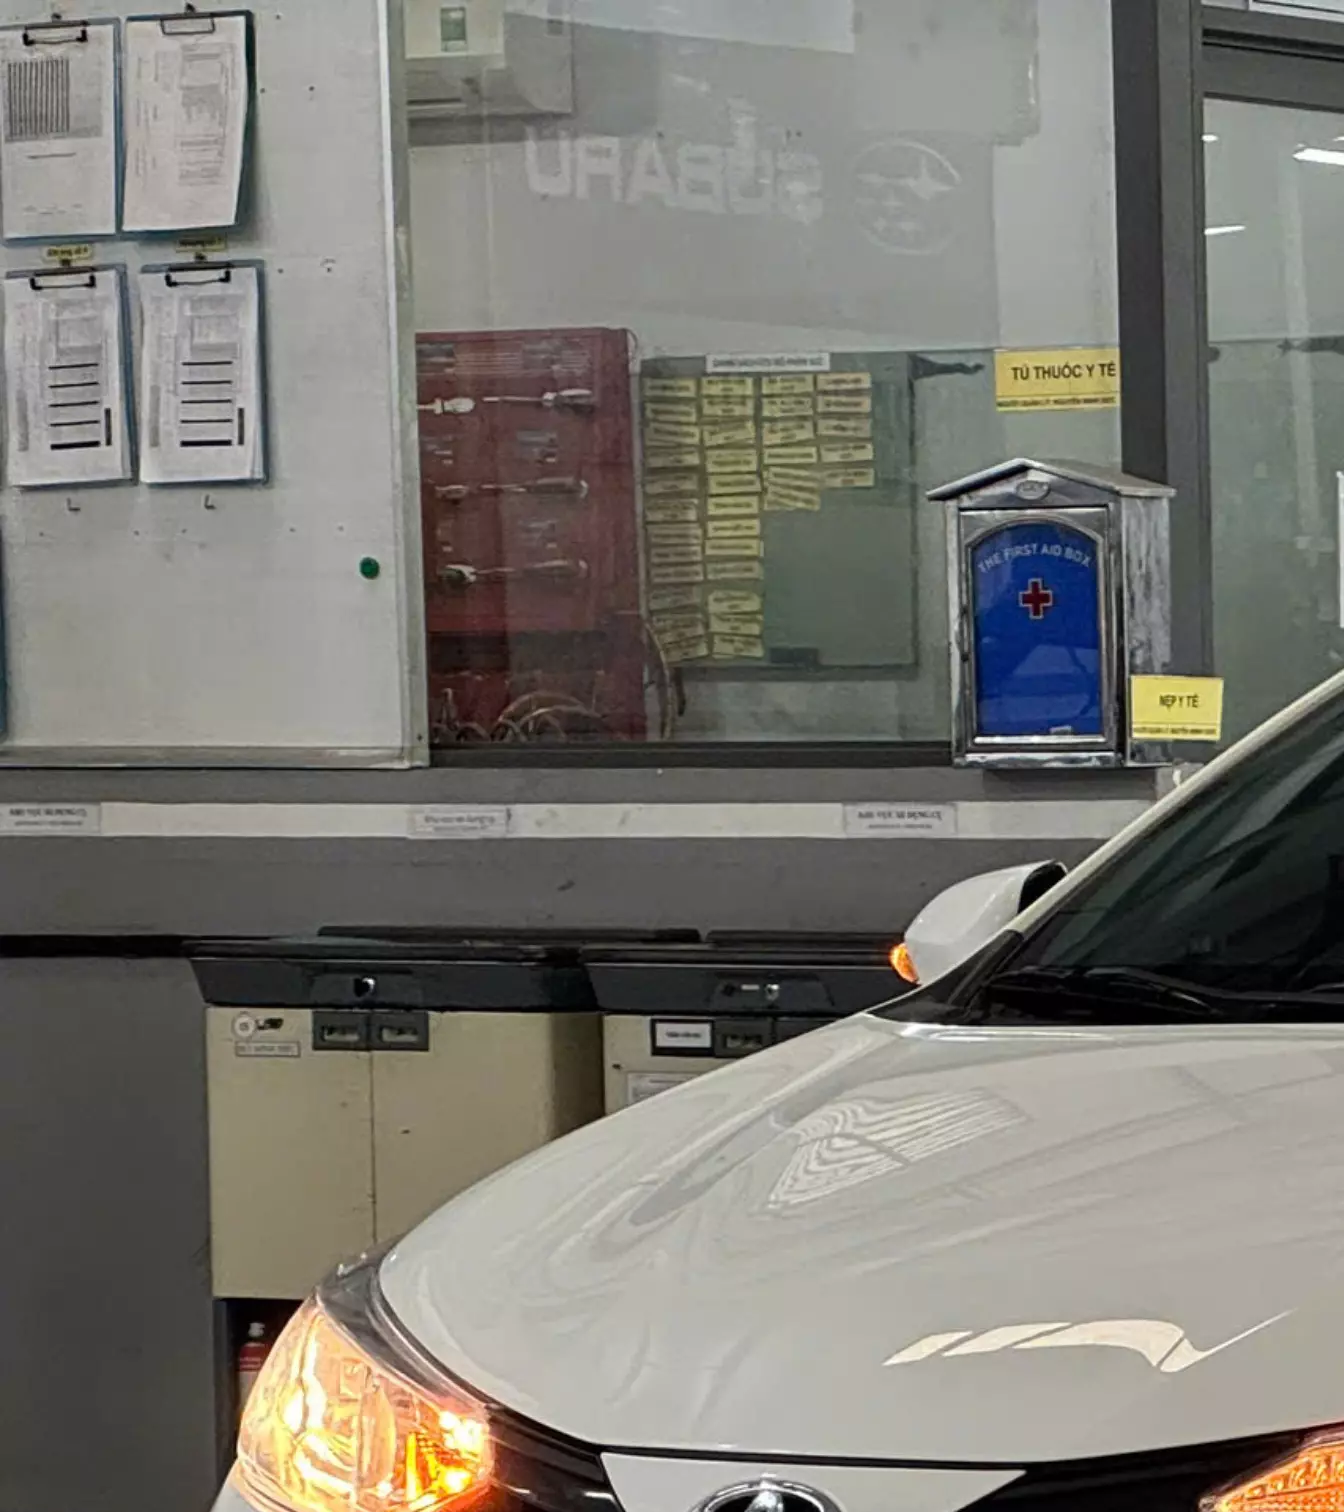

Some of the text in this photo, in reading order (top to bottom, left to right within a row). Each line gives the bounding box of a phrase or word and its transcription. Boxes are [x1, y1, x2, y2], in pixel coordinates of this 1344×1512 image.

[1086, 363, 1095, 377] Y
[977, 543, 1092, 574] THE FIRST AID BOX
